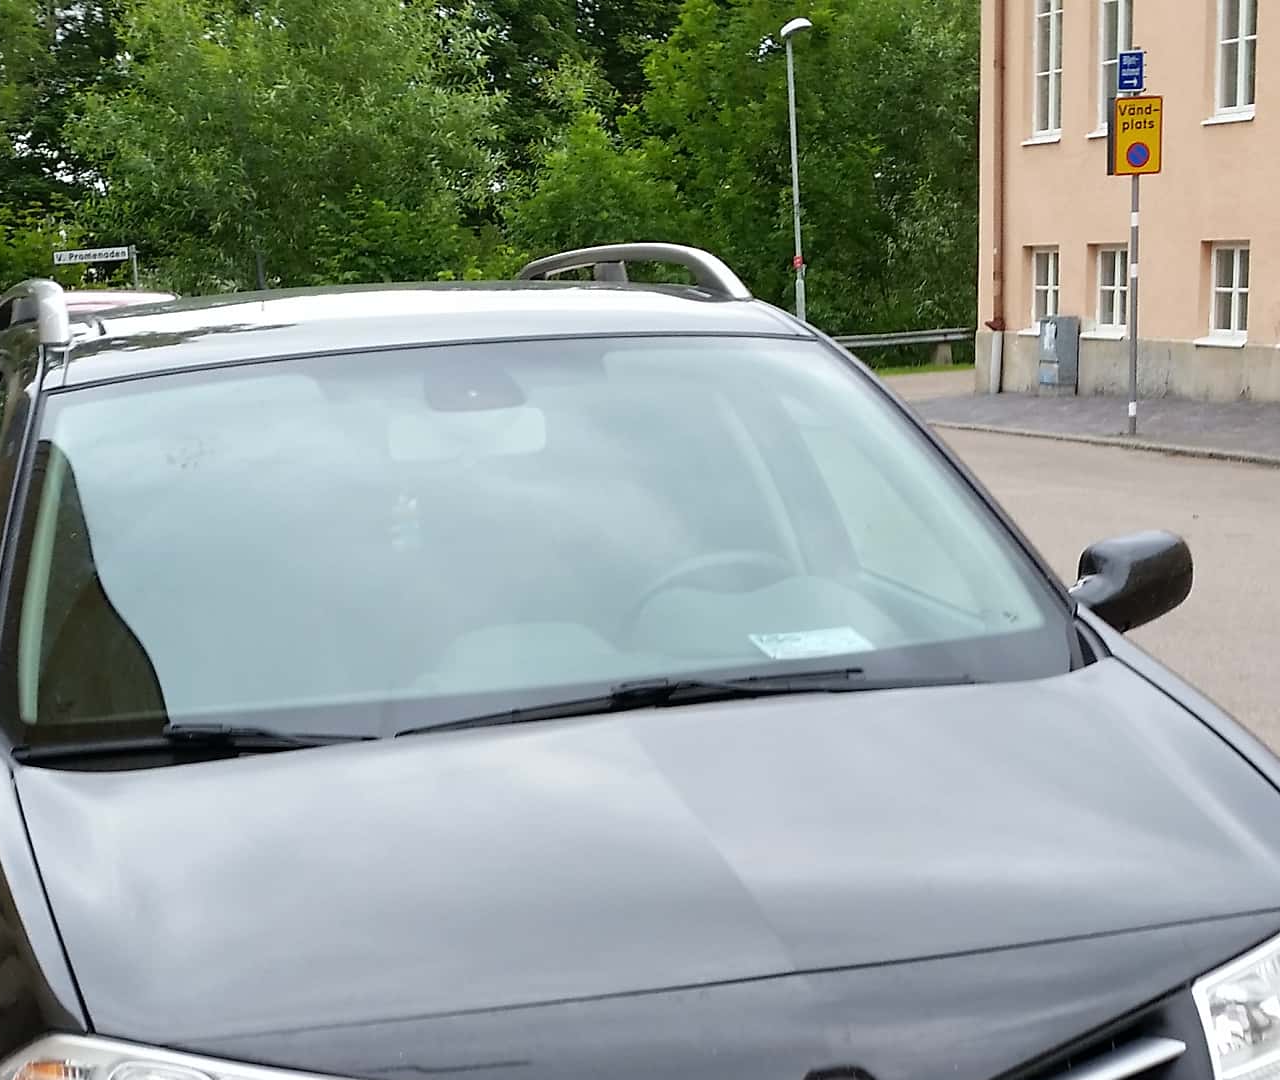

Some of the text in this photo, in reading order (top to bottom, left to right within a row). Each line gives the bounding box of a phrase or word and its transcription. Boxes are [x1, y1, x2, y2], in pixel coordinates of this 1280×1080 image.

[1119, 104, 1160, 116] Vänd-
[1122, 119, 1155, 132] plats
[69, 250, 126, 262] Promenaden
